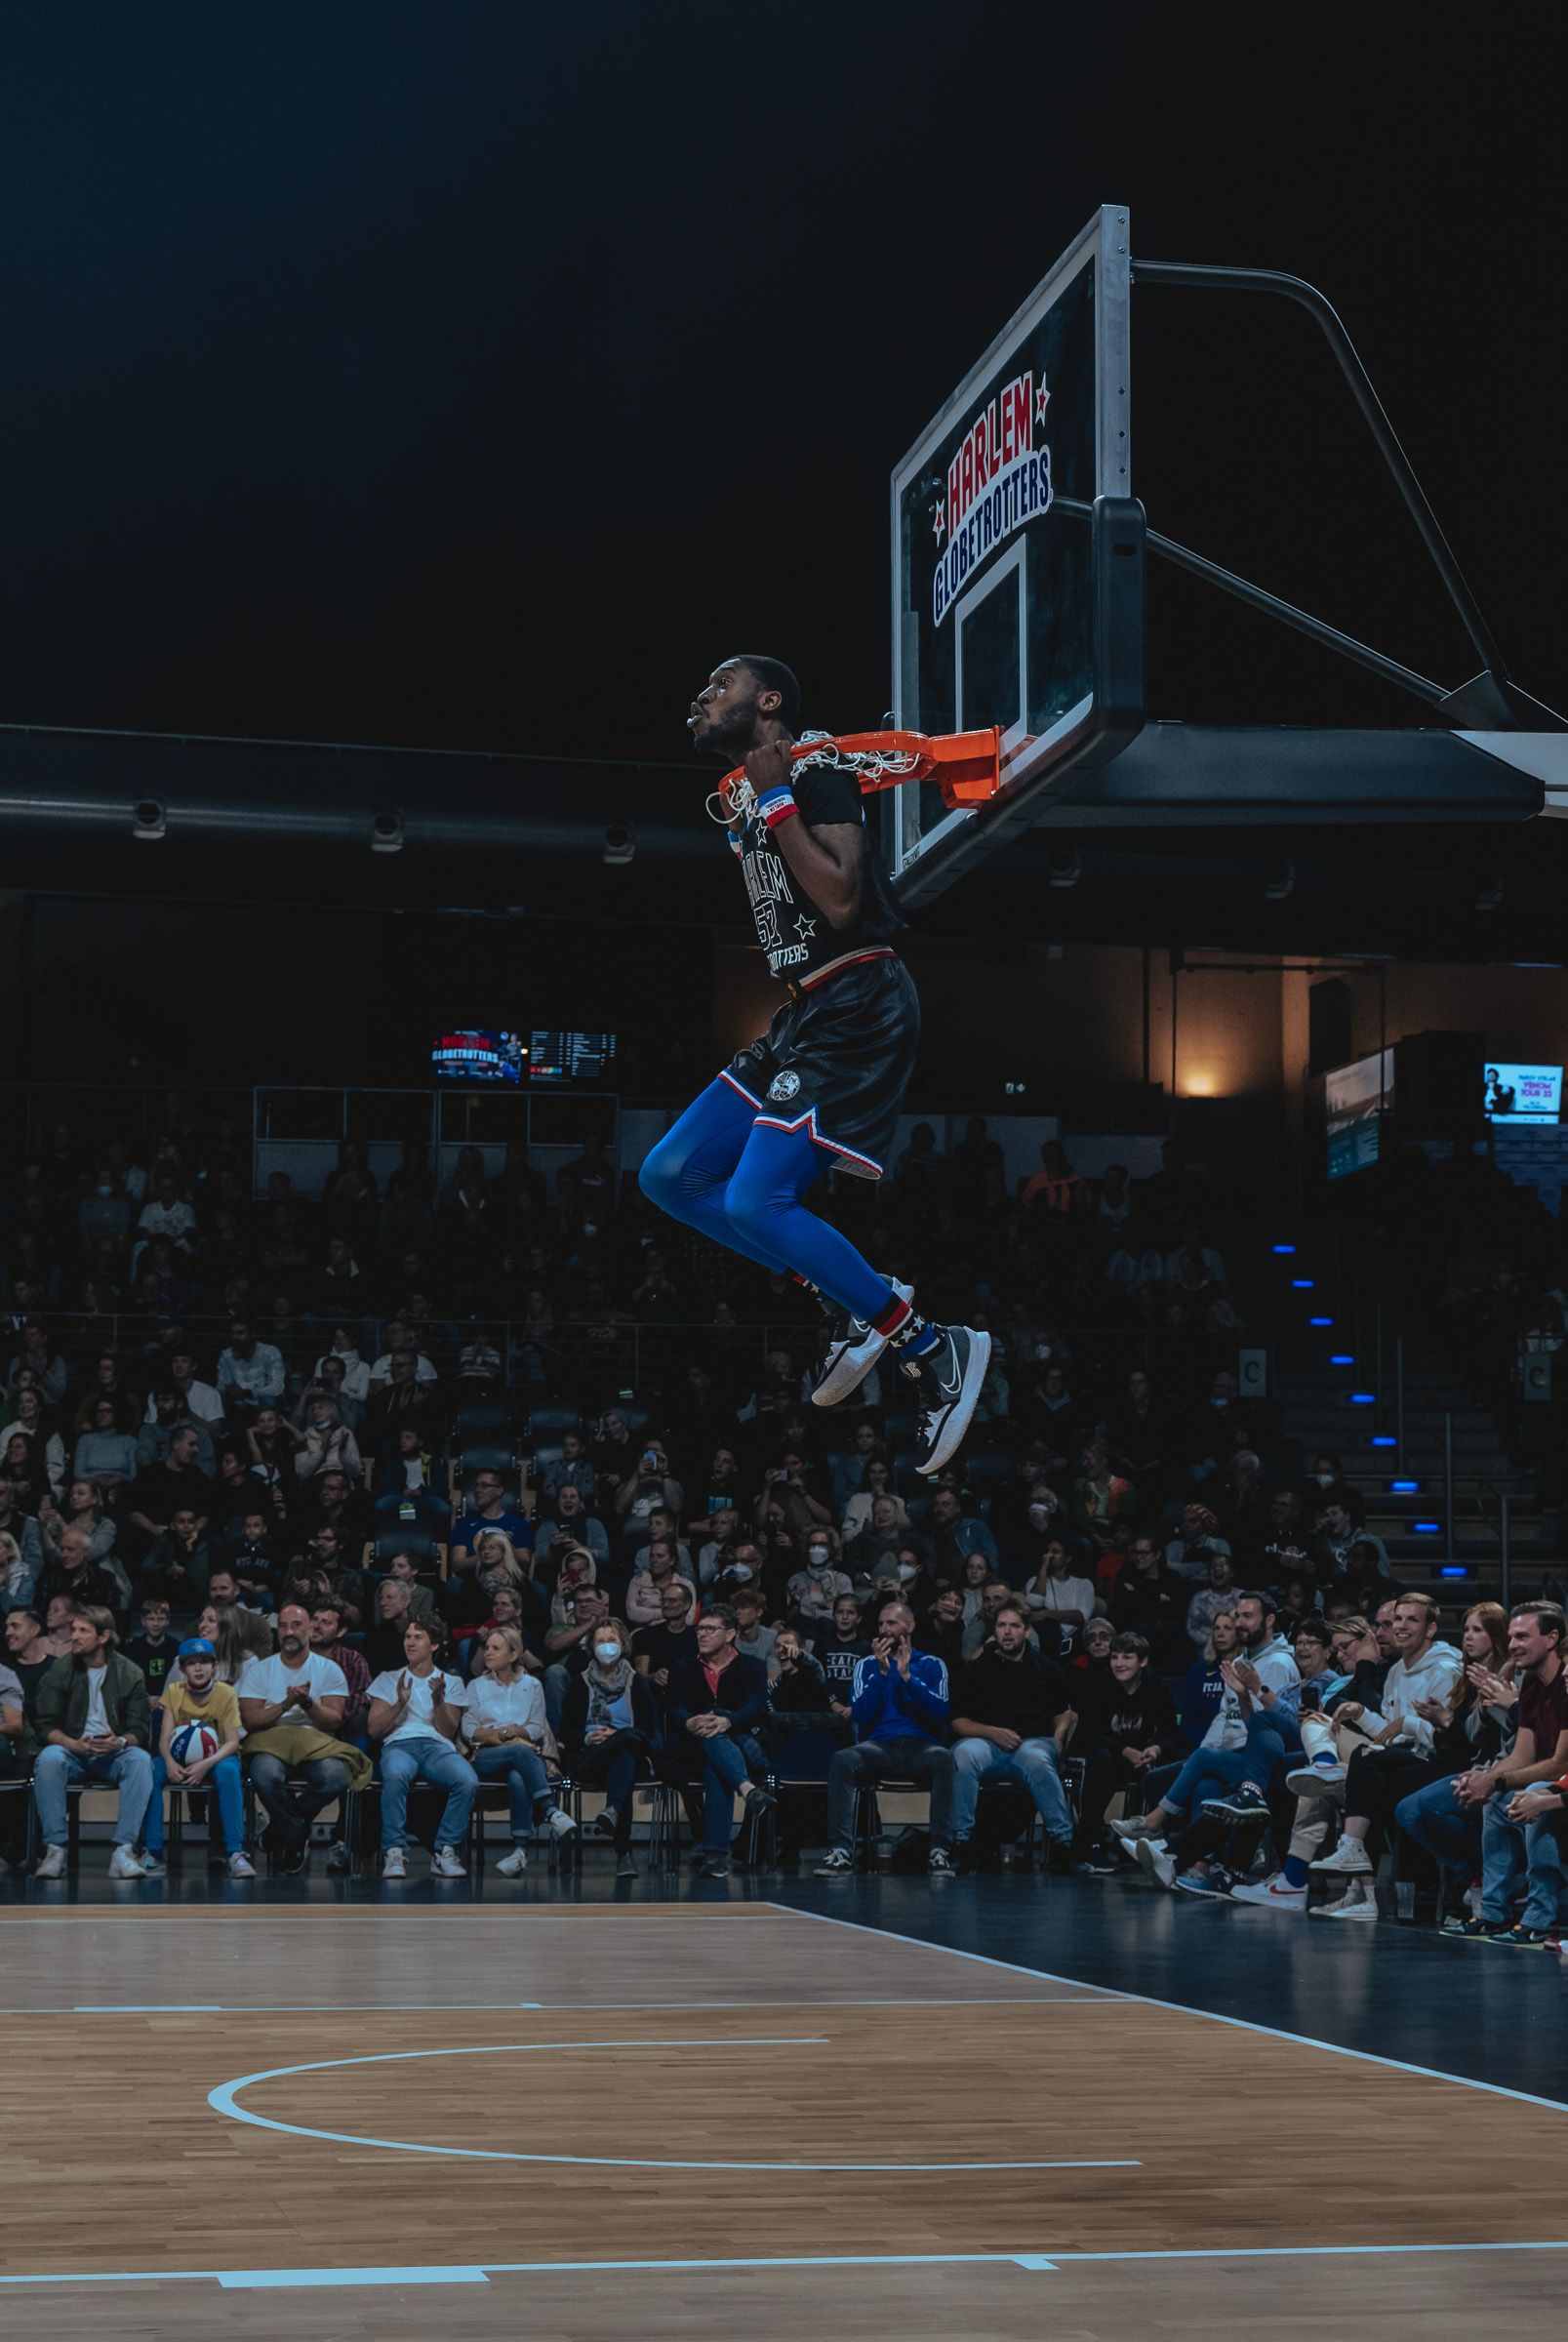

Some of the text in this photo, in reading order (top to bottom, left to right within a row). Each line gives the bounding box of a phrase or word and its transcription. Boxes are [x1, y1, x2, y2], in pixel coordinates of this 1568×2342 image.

[935, 451, 1049, 623] GLOBETROTTERS
[947, 377, 1031, 540] HARLEM
[1245, 1361, 1260, 1383] C
